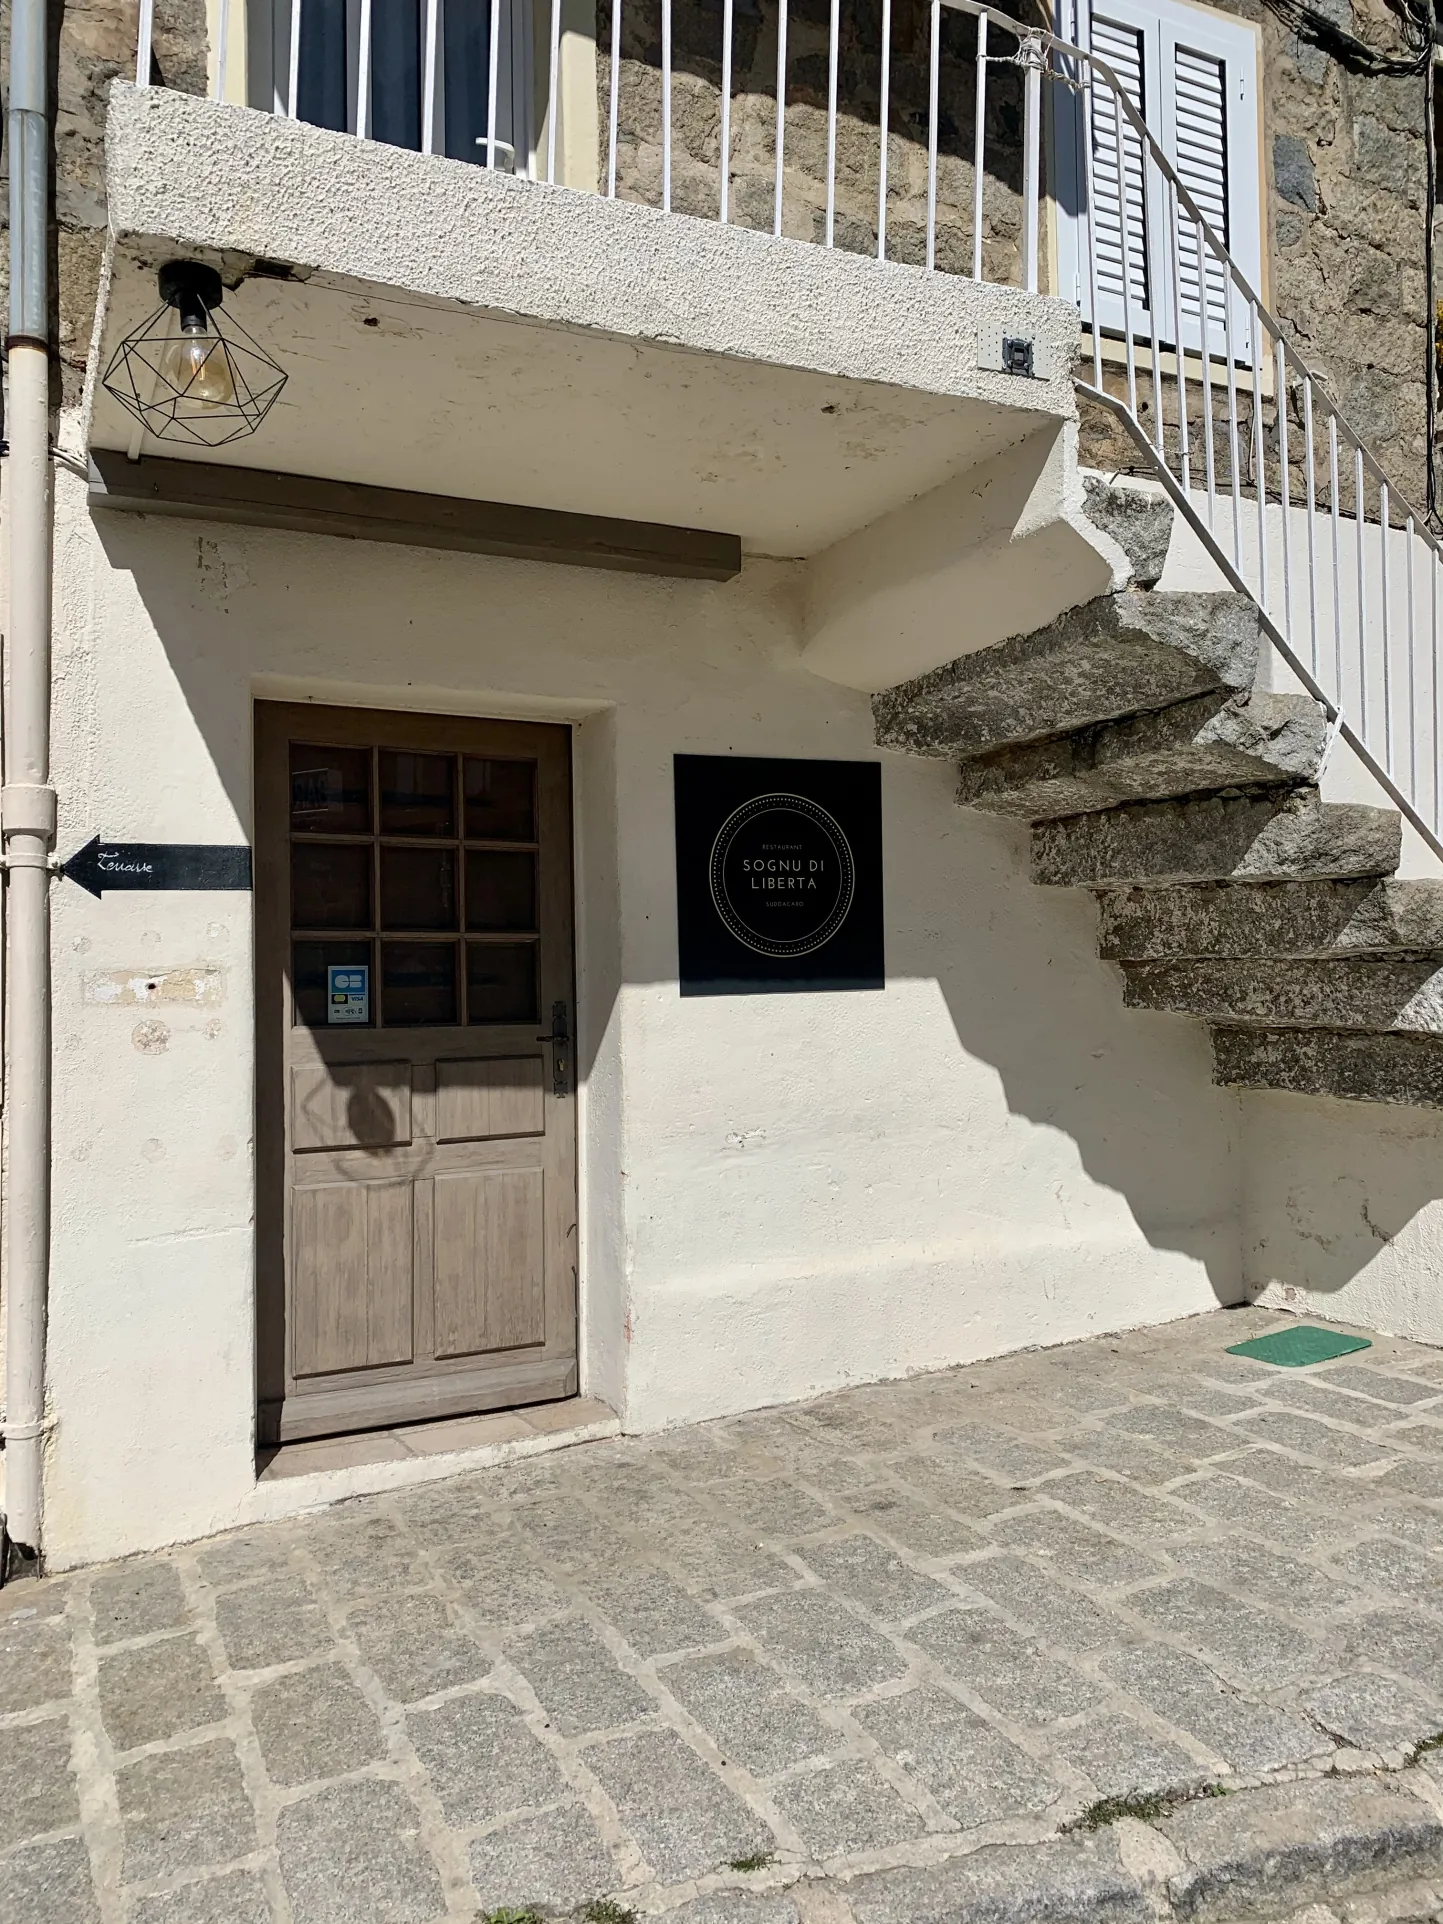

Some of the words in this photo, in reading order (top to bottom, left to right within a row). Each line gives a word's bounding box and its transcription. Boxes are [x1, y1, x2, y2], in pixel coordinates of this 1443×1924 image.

[743, 859, 801, 872] SOGNU
[809, 859, 824, 872] DI
[751, 877, 817, 890] LIBERTA
